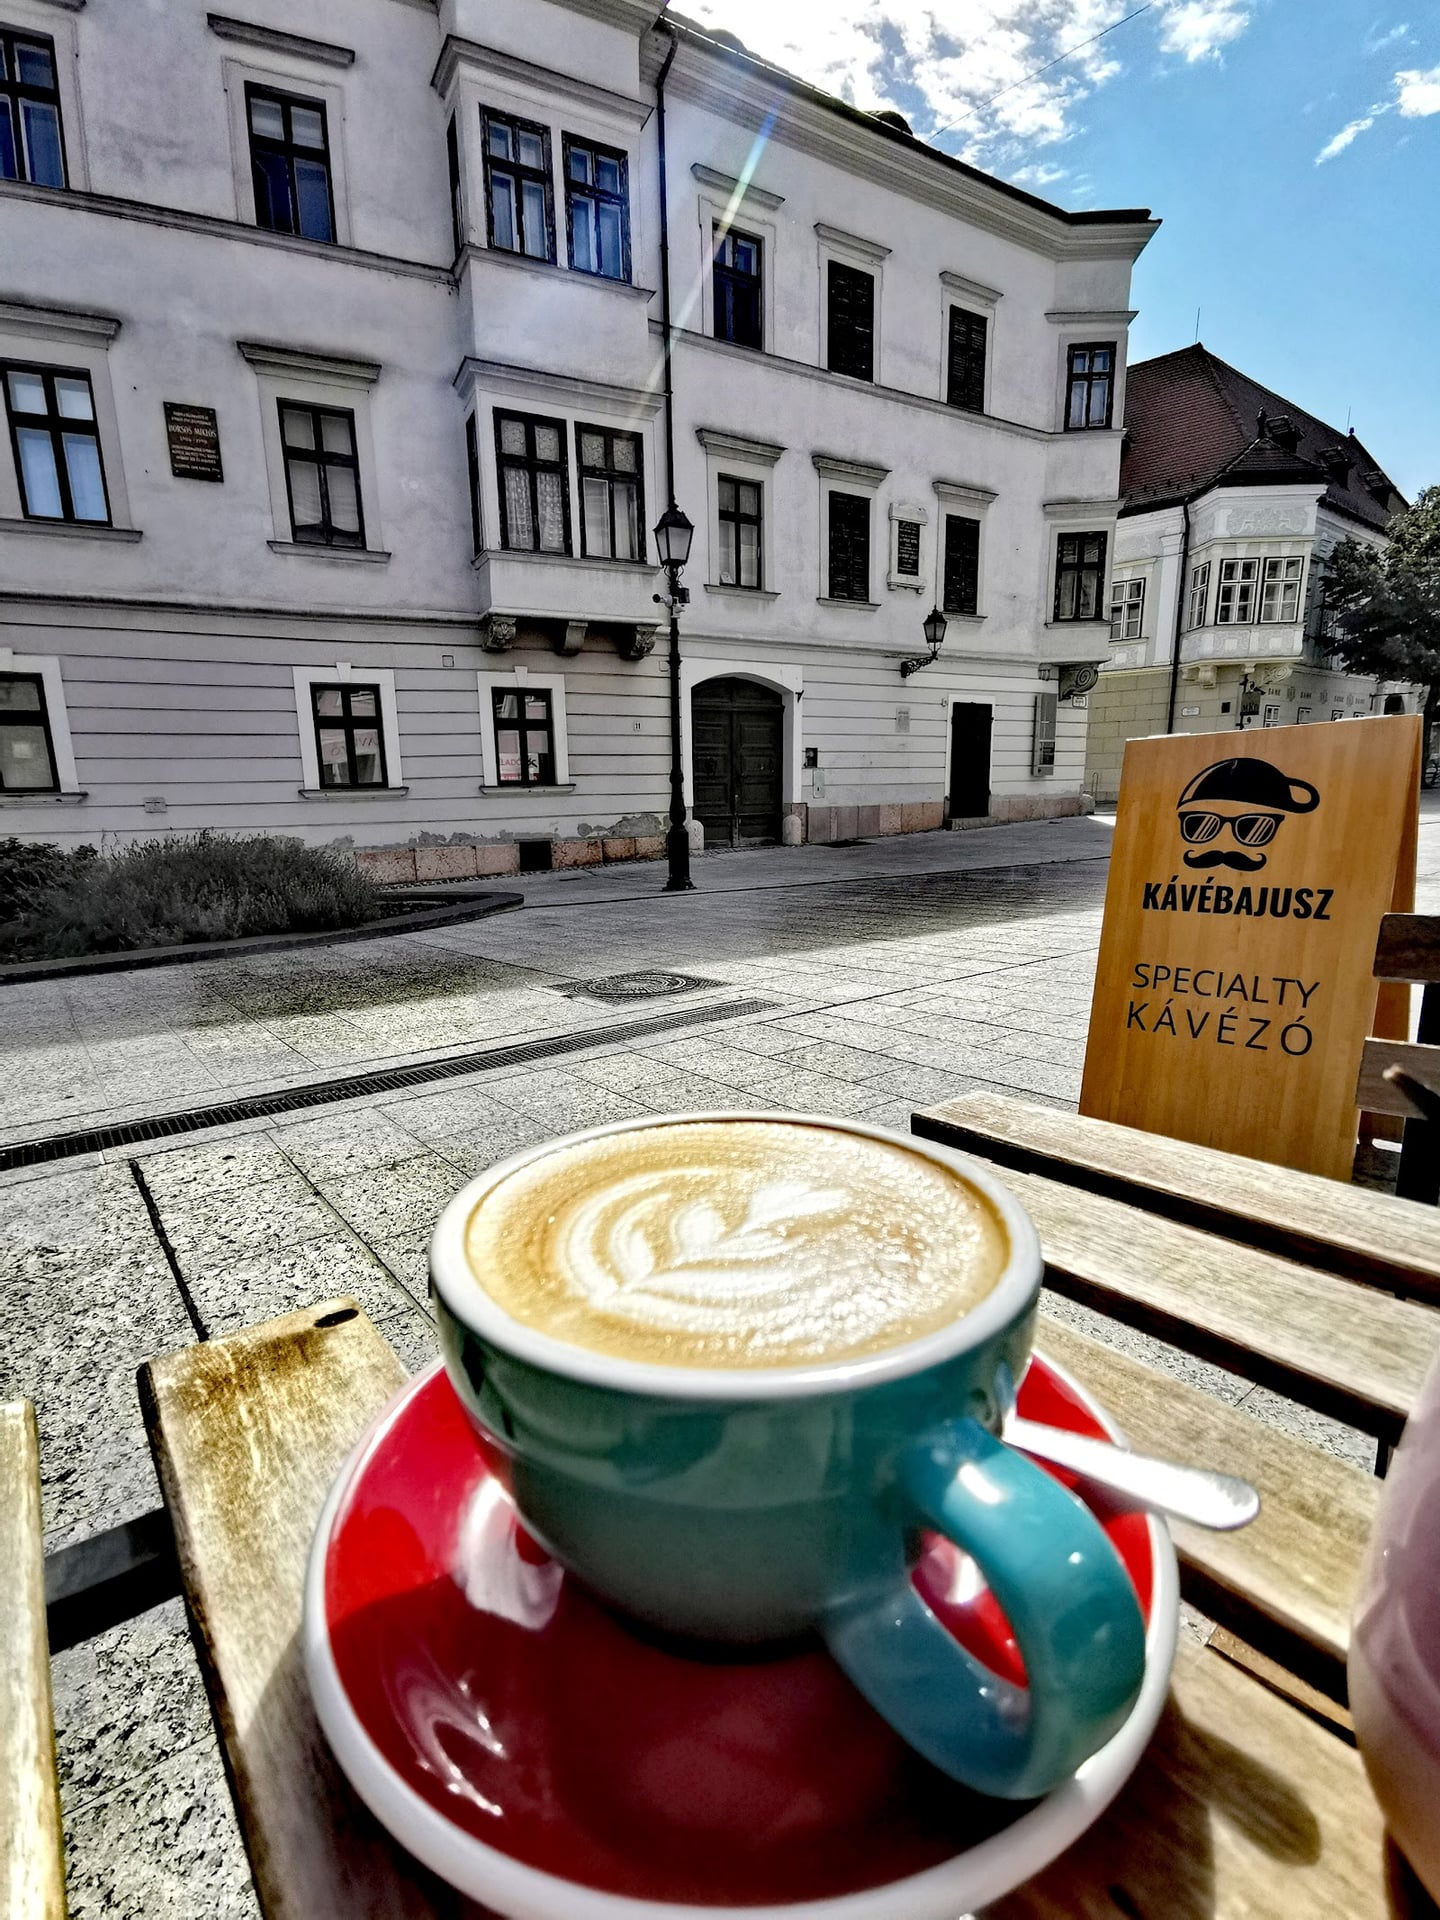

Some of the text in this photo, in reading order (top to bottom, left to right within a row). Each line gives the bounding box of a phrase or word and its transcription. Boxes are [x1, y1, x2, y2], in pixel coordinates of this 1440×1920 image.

[1143, 875, 1334, 920] KÁVÉBAJUSZ
[1132, 963, 1320, 1008] SPECIALTY
[1127, 999, 1313, 1056] KÁVÉZÓ
